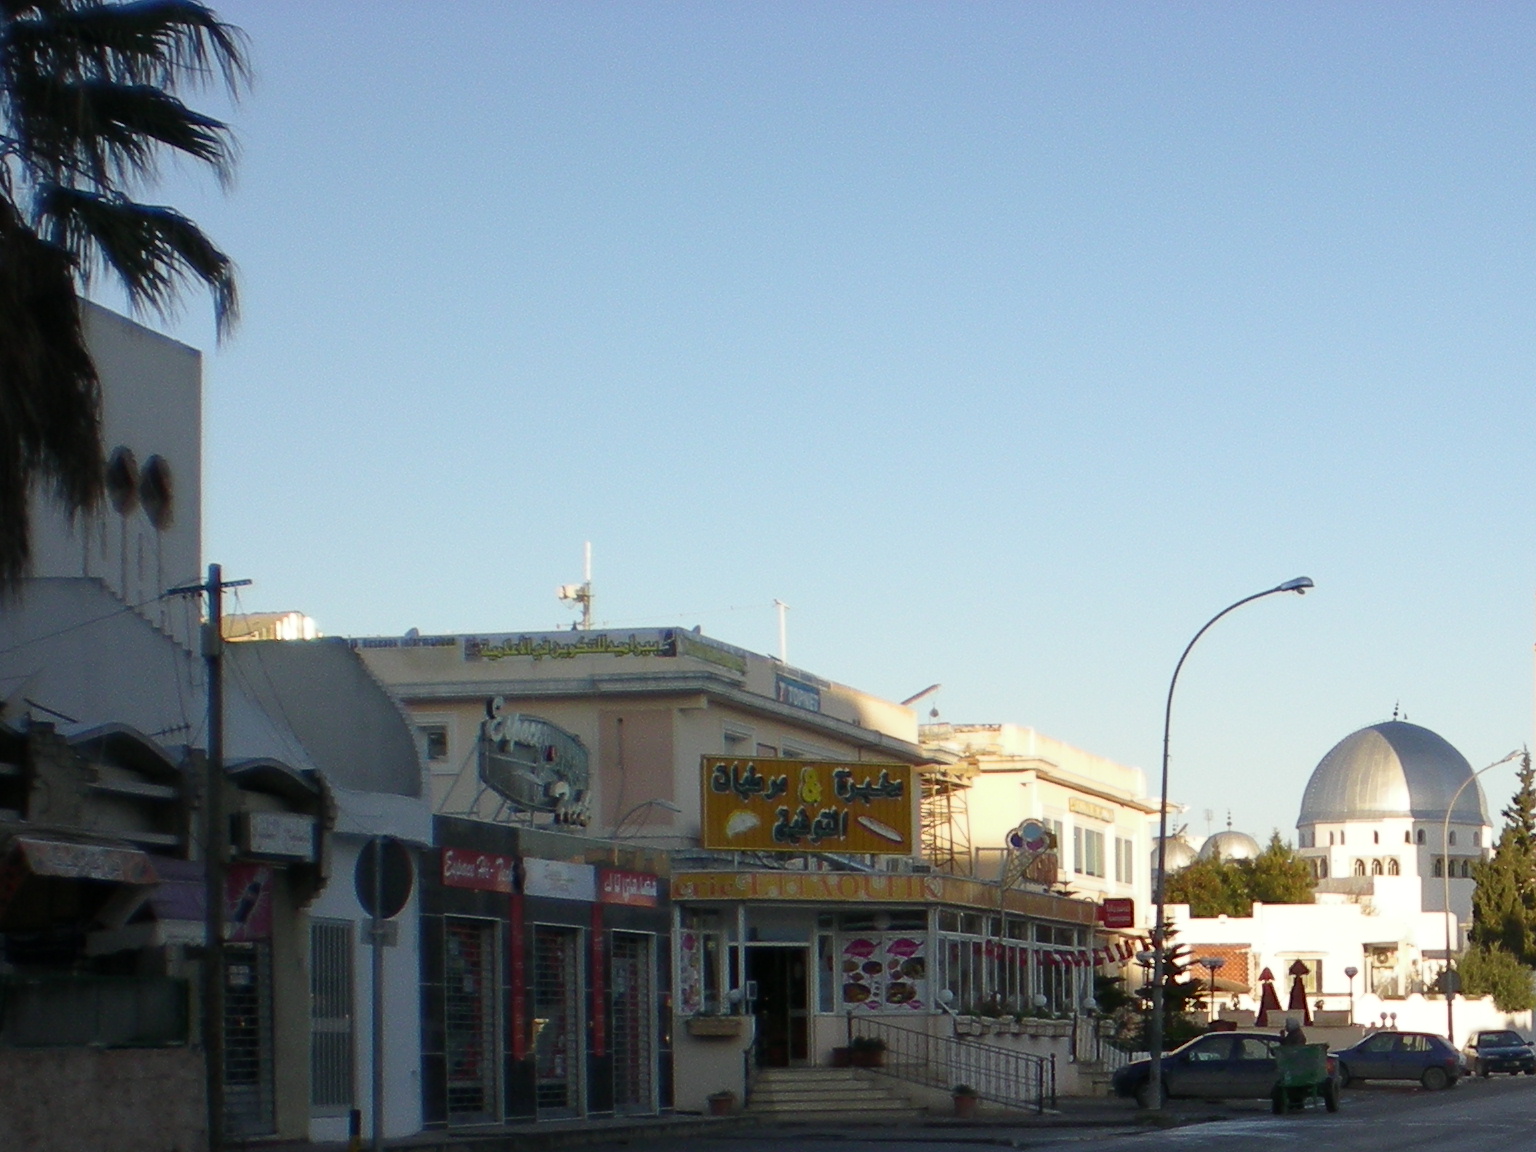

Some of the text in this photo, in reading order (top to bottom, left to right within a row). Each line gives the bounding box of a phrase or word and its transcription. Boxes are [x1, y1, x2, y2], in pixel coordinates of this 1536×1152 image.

[711, 761, 904, 806] مخبزة & مرطبات
[773, 806, 848, 845] التوفيق
